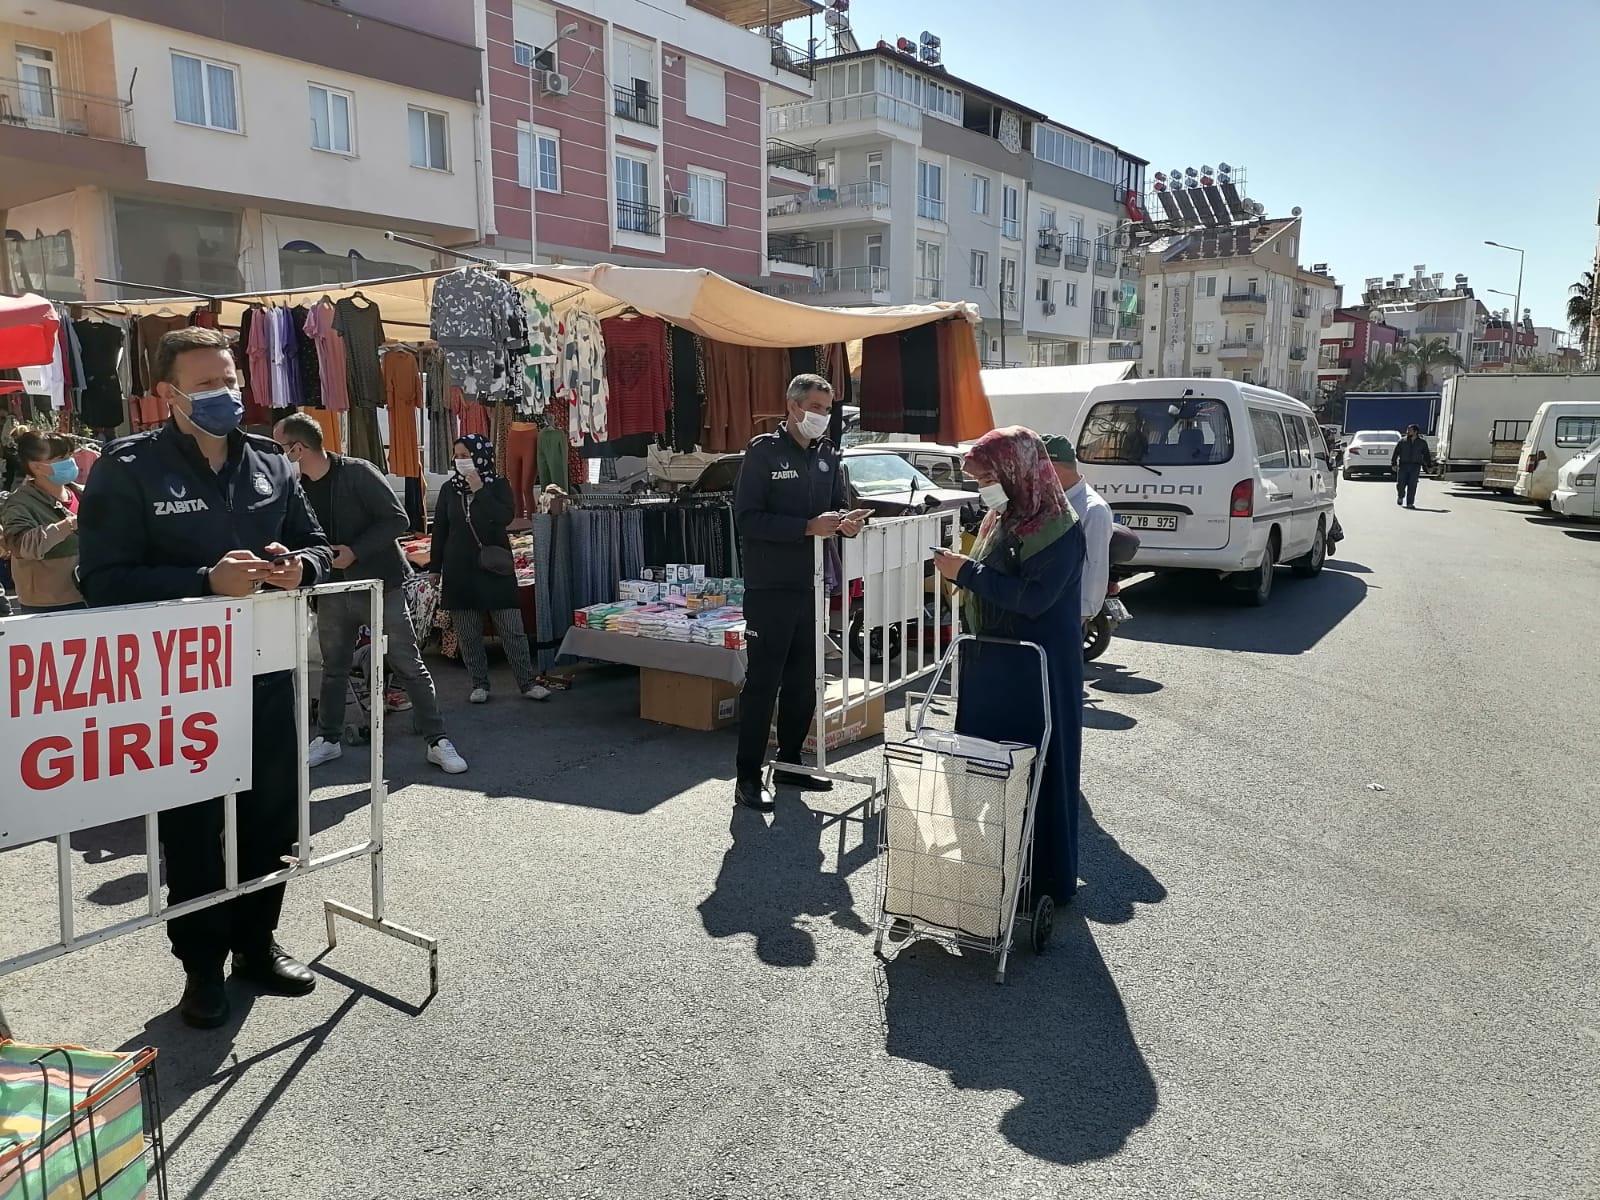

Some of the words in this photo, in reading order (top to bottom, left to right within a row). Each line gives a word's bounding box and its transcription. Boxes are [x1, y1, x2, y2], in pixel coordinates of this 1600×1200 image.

[771, 470, 799, 480] ZABITA
[1094, 483, 1203, 496] HYUNDAI
[153, 498, 209, 516] ZABITA
[1120, 515, 1133, 527] 07
[1137, 516, 1149, 527] YB
[1156, 517, 1175, 528] 975
[9, 633, 142, 719] PAZAR
[152, 607, 233, 697] YERİ
[20, 704, 219, 791] GİRİŞ
